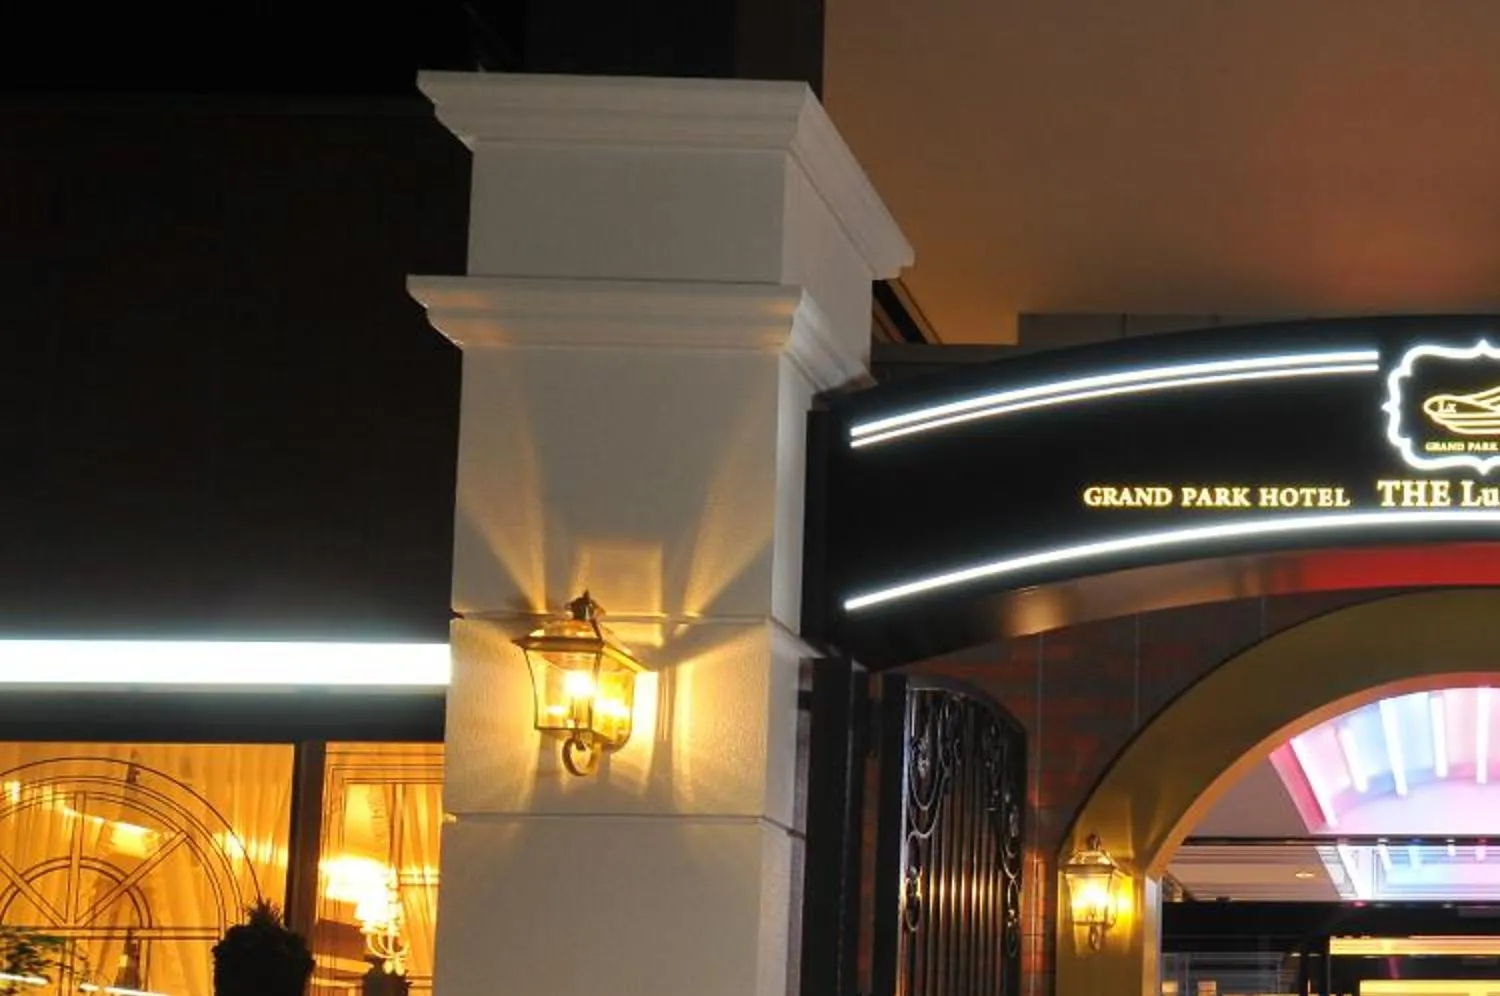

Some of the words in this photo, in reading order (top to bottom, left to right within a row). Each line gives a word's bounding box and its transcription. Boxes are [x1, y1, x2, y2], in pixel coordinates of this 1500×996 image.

[1425, 441, 1465, 452] GRAND
[1467, 441, 1499, 452] PARK
[1083, 487, 1173, 507] GRAND
[1181, 487, 1252, 507] PARK
[1258, 487, 1351, 507] HOTEL
[1376, 479, 1452, 508] THE
